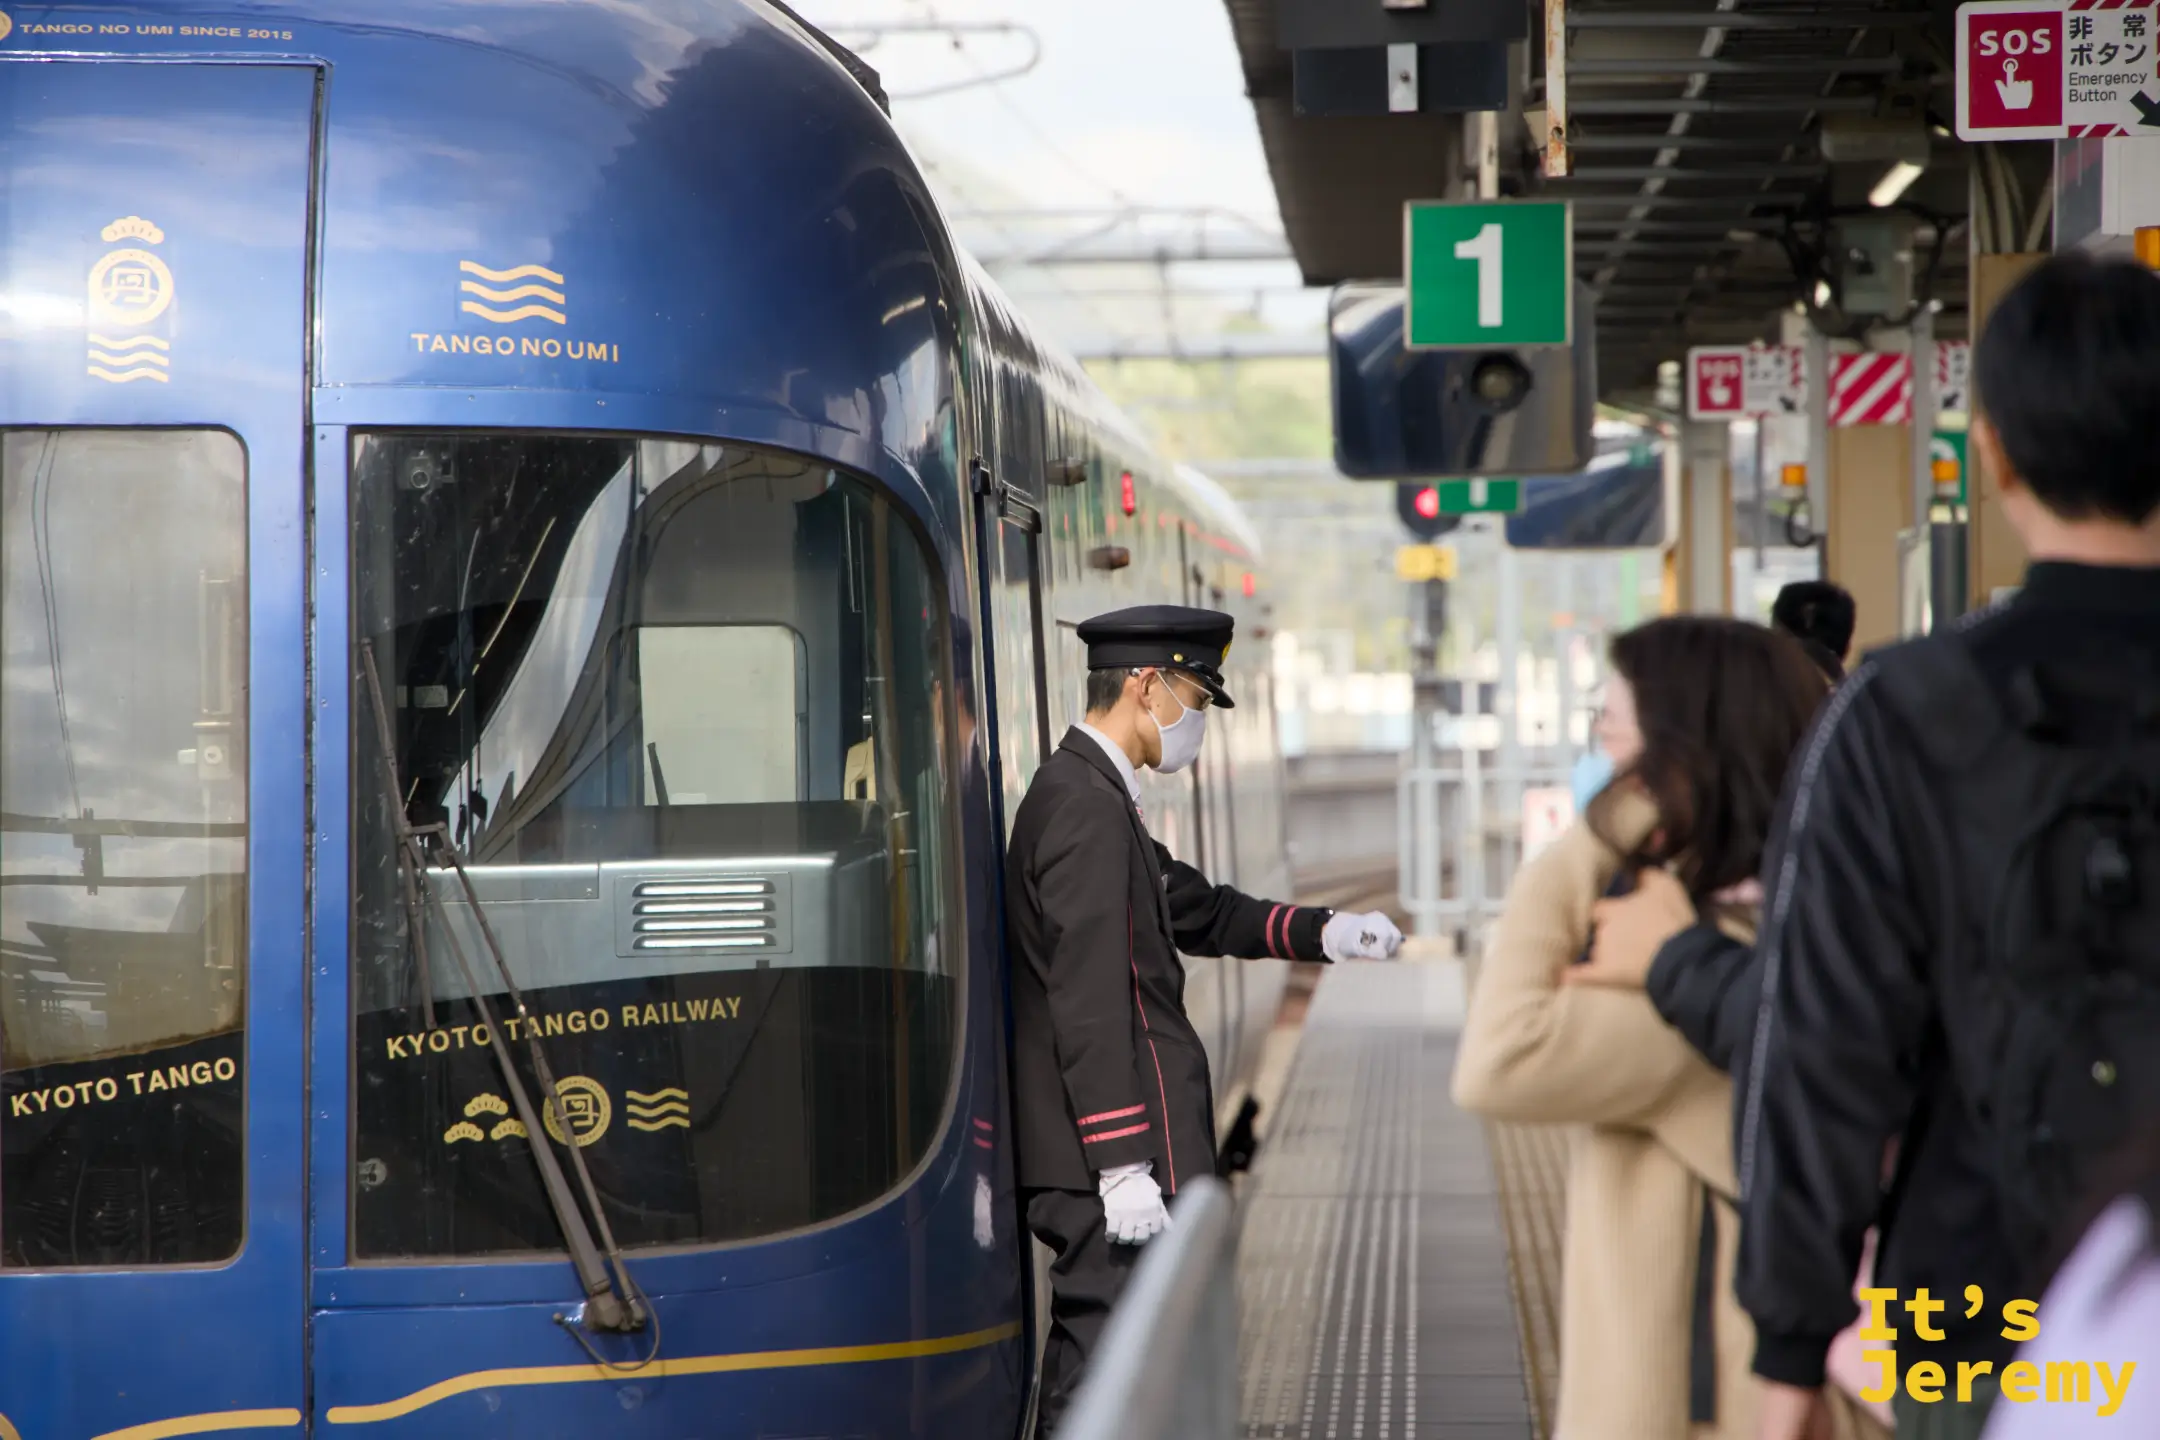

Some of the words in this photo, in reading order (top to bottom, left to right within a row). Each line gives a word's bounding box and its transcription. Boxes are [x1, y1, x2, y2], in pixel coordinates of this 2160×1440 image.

[20, 23, 93, 34] TANGO
[100, 24, 130, 35] NO
[136, 25, 174, 36] UMI
[180, 25, 242, 37] SINCE
[248, 28, 293, 41] 2015
[1979, 28, 2051, 56] SOS
[2070, 42, 2147, 66] ボタン
[2068, 72, 2148, 87] Emergency
[2068, 89, 2118, 103] Button
[1453, 222, 1503, 328] 1
[411, 333, 515, 356] TANGO
[521, 338, 562, 357] NO
[567, 341, 619, 363] UMI
[386, 1024, 492, 1060] KYOTO
[504, 1008, 610, 1041] TANGO
[622, 996, 742, 1028] RAILWAY
[11, 1077, 119, 1117] KYOTO
[126, 1057, 236, 1095] TANGO
